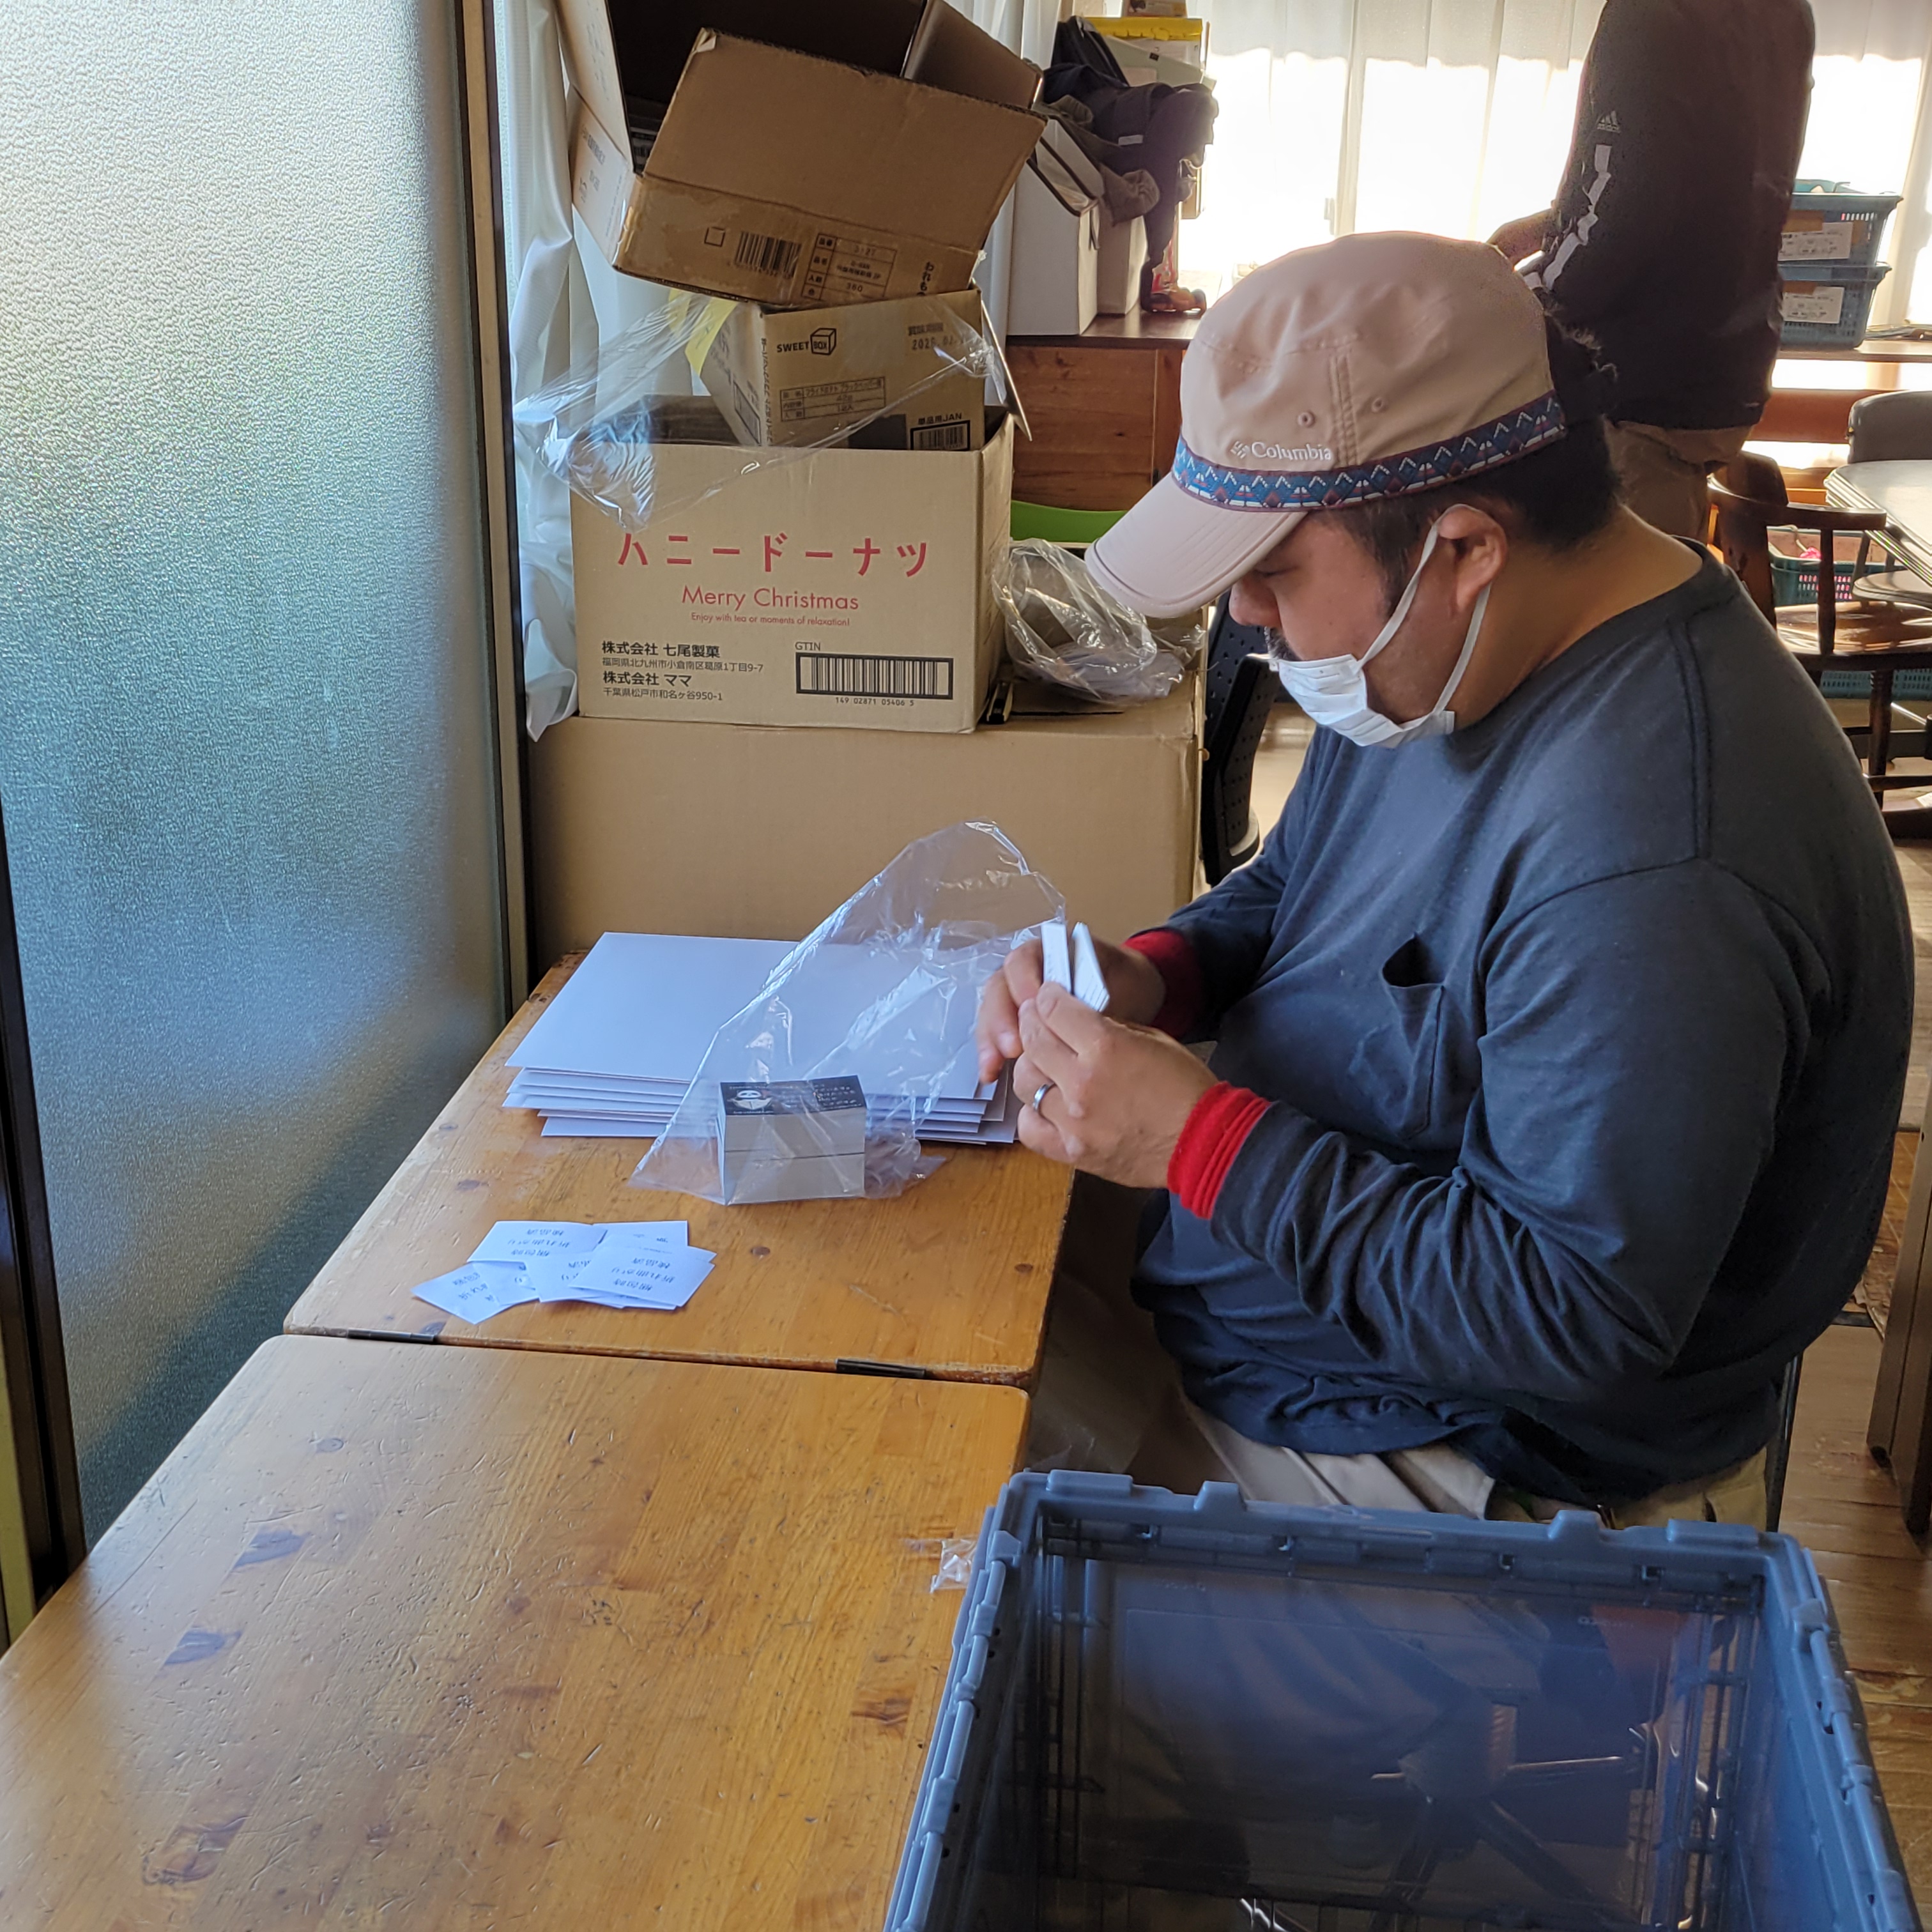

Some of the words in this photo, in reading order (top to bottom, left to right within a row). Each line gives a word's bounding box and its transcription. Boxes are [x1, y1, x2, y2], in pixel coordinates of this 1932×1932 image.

[776, 341, 809, 353] SWEET
[813, 341, 828, 350] BOX
[917, 413, 962, 425] 単品用JAN
[1251, 441, 1332, 461] Columbia
[618, 533, 927, 577] ハニードーナツ
[682, 585, 746, 611] Merry
[754, 588, 859, 610] Christmas
[691, 612, 714, 623] Enjoy
[715, 613, 732, 622] with
[734, 615, 747, 623] tea
[760, 617, 795, 625] moments
[797, 616, 806, 625] of
[807, 617, 850, 627] relaxation!
[602, 641, 659, 656] 株式会社
[663, 643, 721, 658] 七尾製菓
[795, 641, 821, 652] GTIN
[603, 671, 659, 686] 株式会社
[664, 674, 692, 687] ママ
